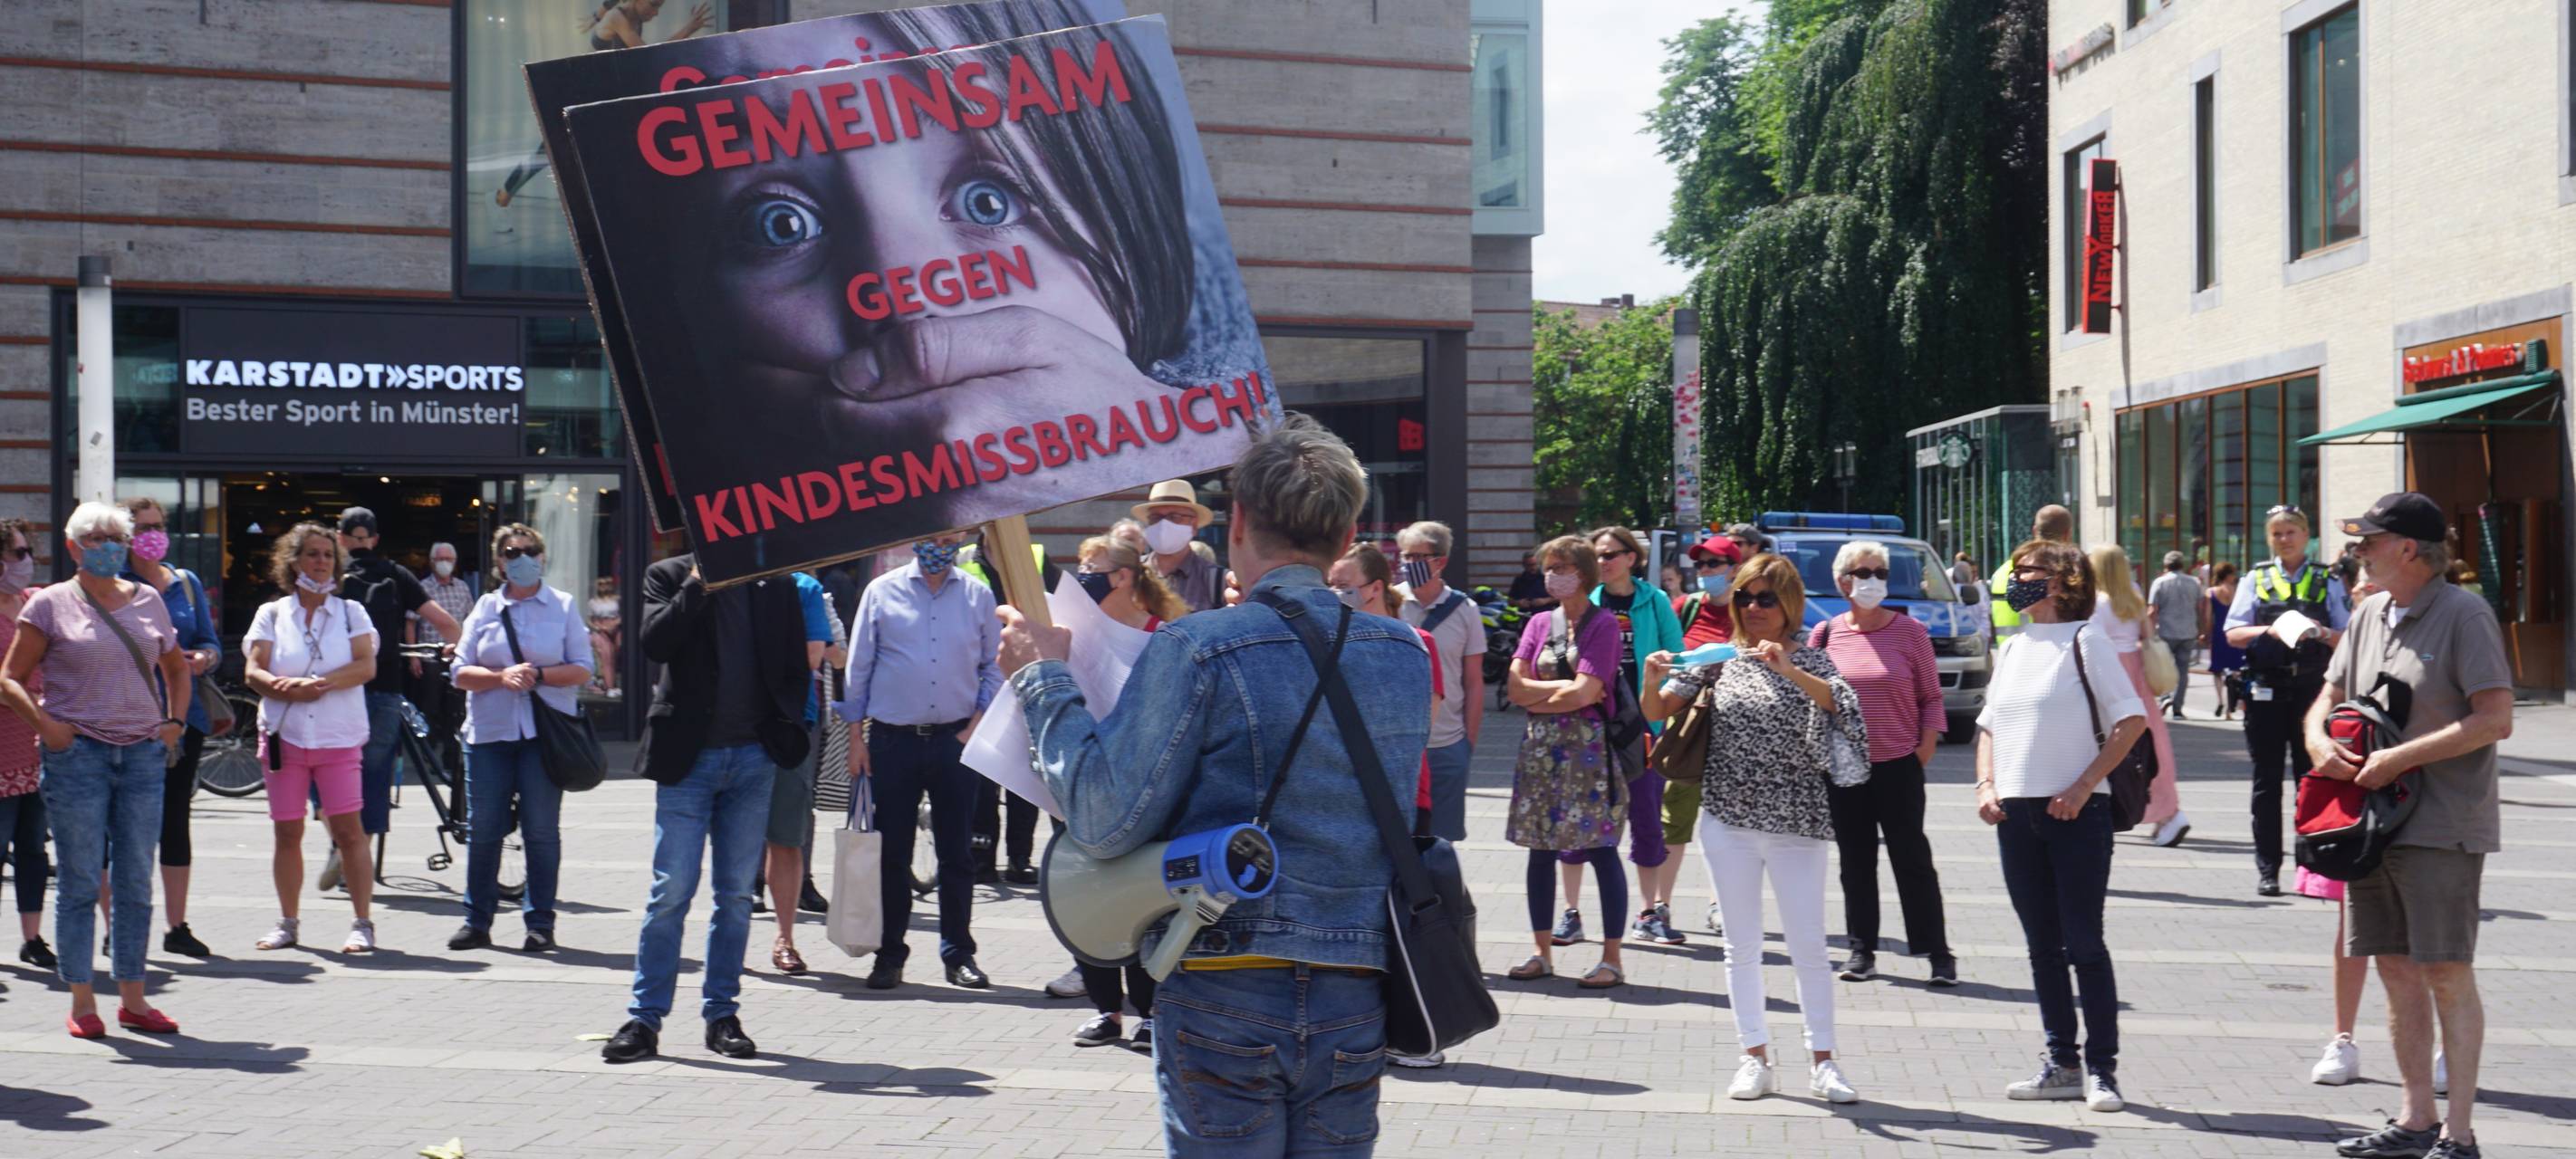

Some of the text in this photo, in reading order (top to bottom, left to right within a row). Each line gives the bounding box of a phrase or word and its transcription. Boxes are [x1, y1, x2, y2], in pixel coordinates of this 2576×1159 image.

[637, 39, 1131, 177] GEMEINSAM
[846, 244, 1036, 321] GEGEN
[186, 397, 520, 427] Bester Sport in Münster!
[694, 371, 1266, 542] KINDESMISSBRAUCH!
